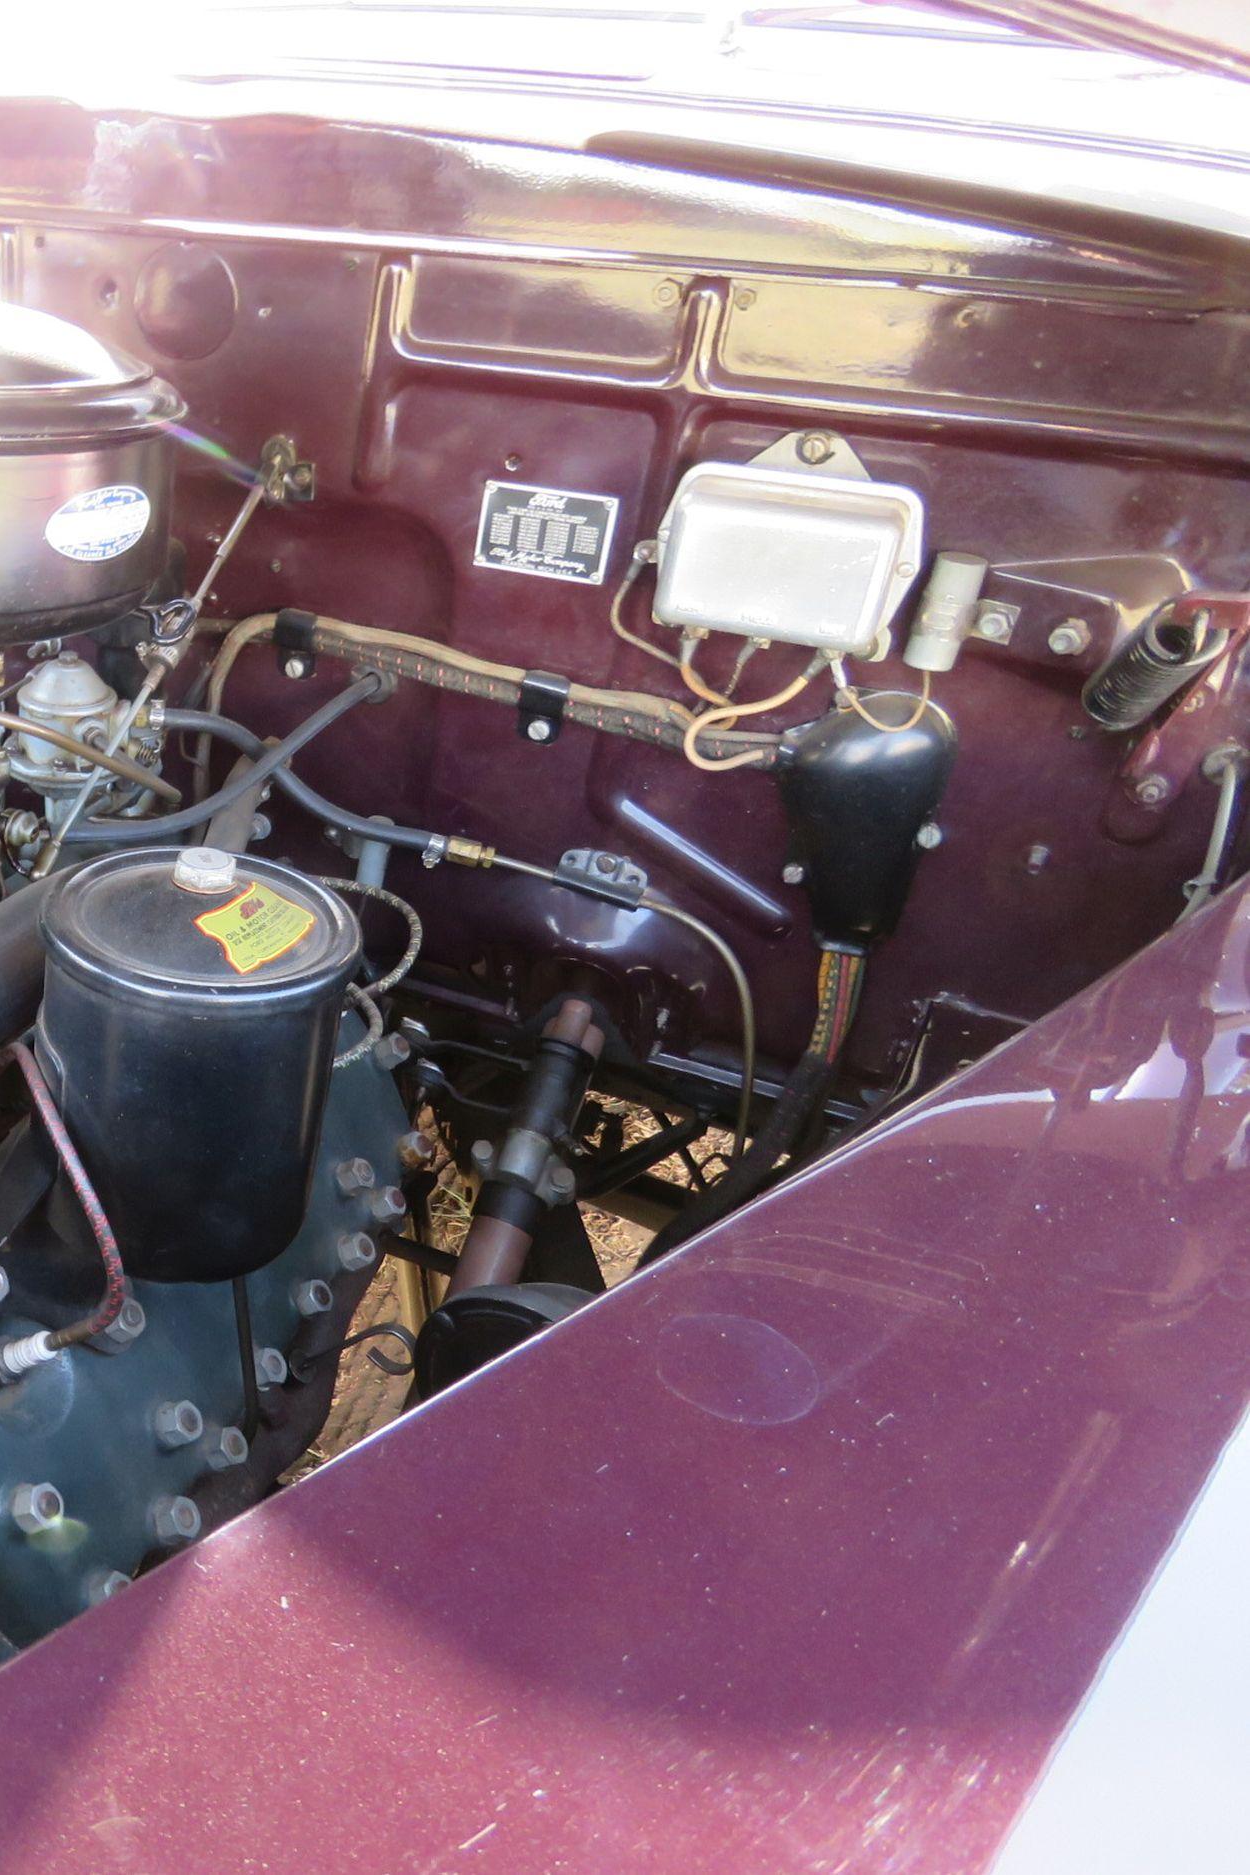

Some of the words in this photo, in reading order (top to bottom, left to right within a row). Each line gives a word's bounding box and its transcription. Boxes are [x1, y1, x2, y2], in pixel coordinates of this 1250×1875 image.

[528, 493, 567, 509] Ford
[225, 929, 241, 941] OIL
[247, 912, 269, 929] MOTOR
